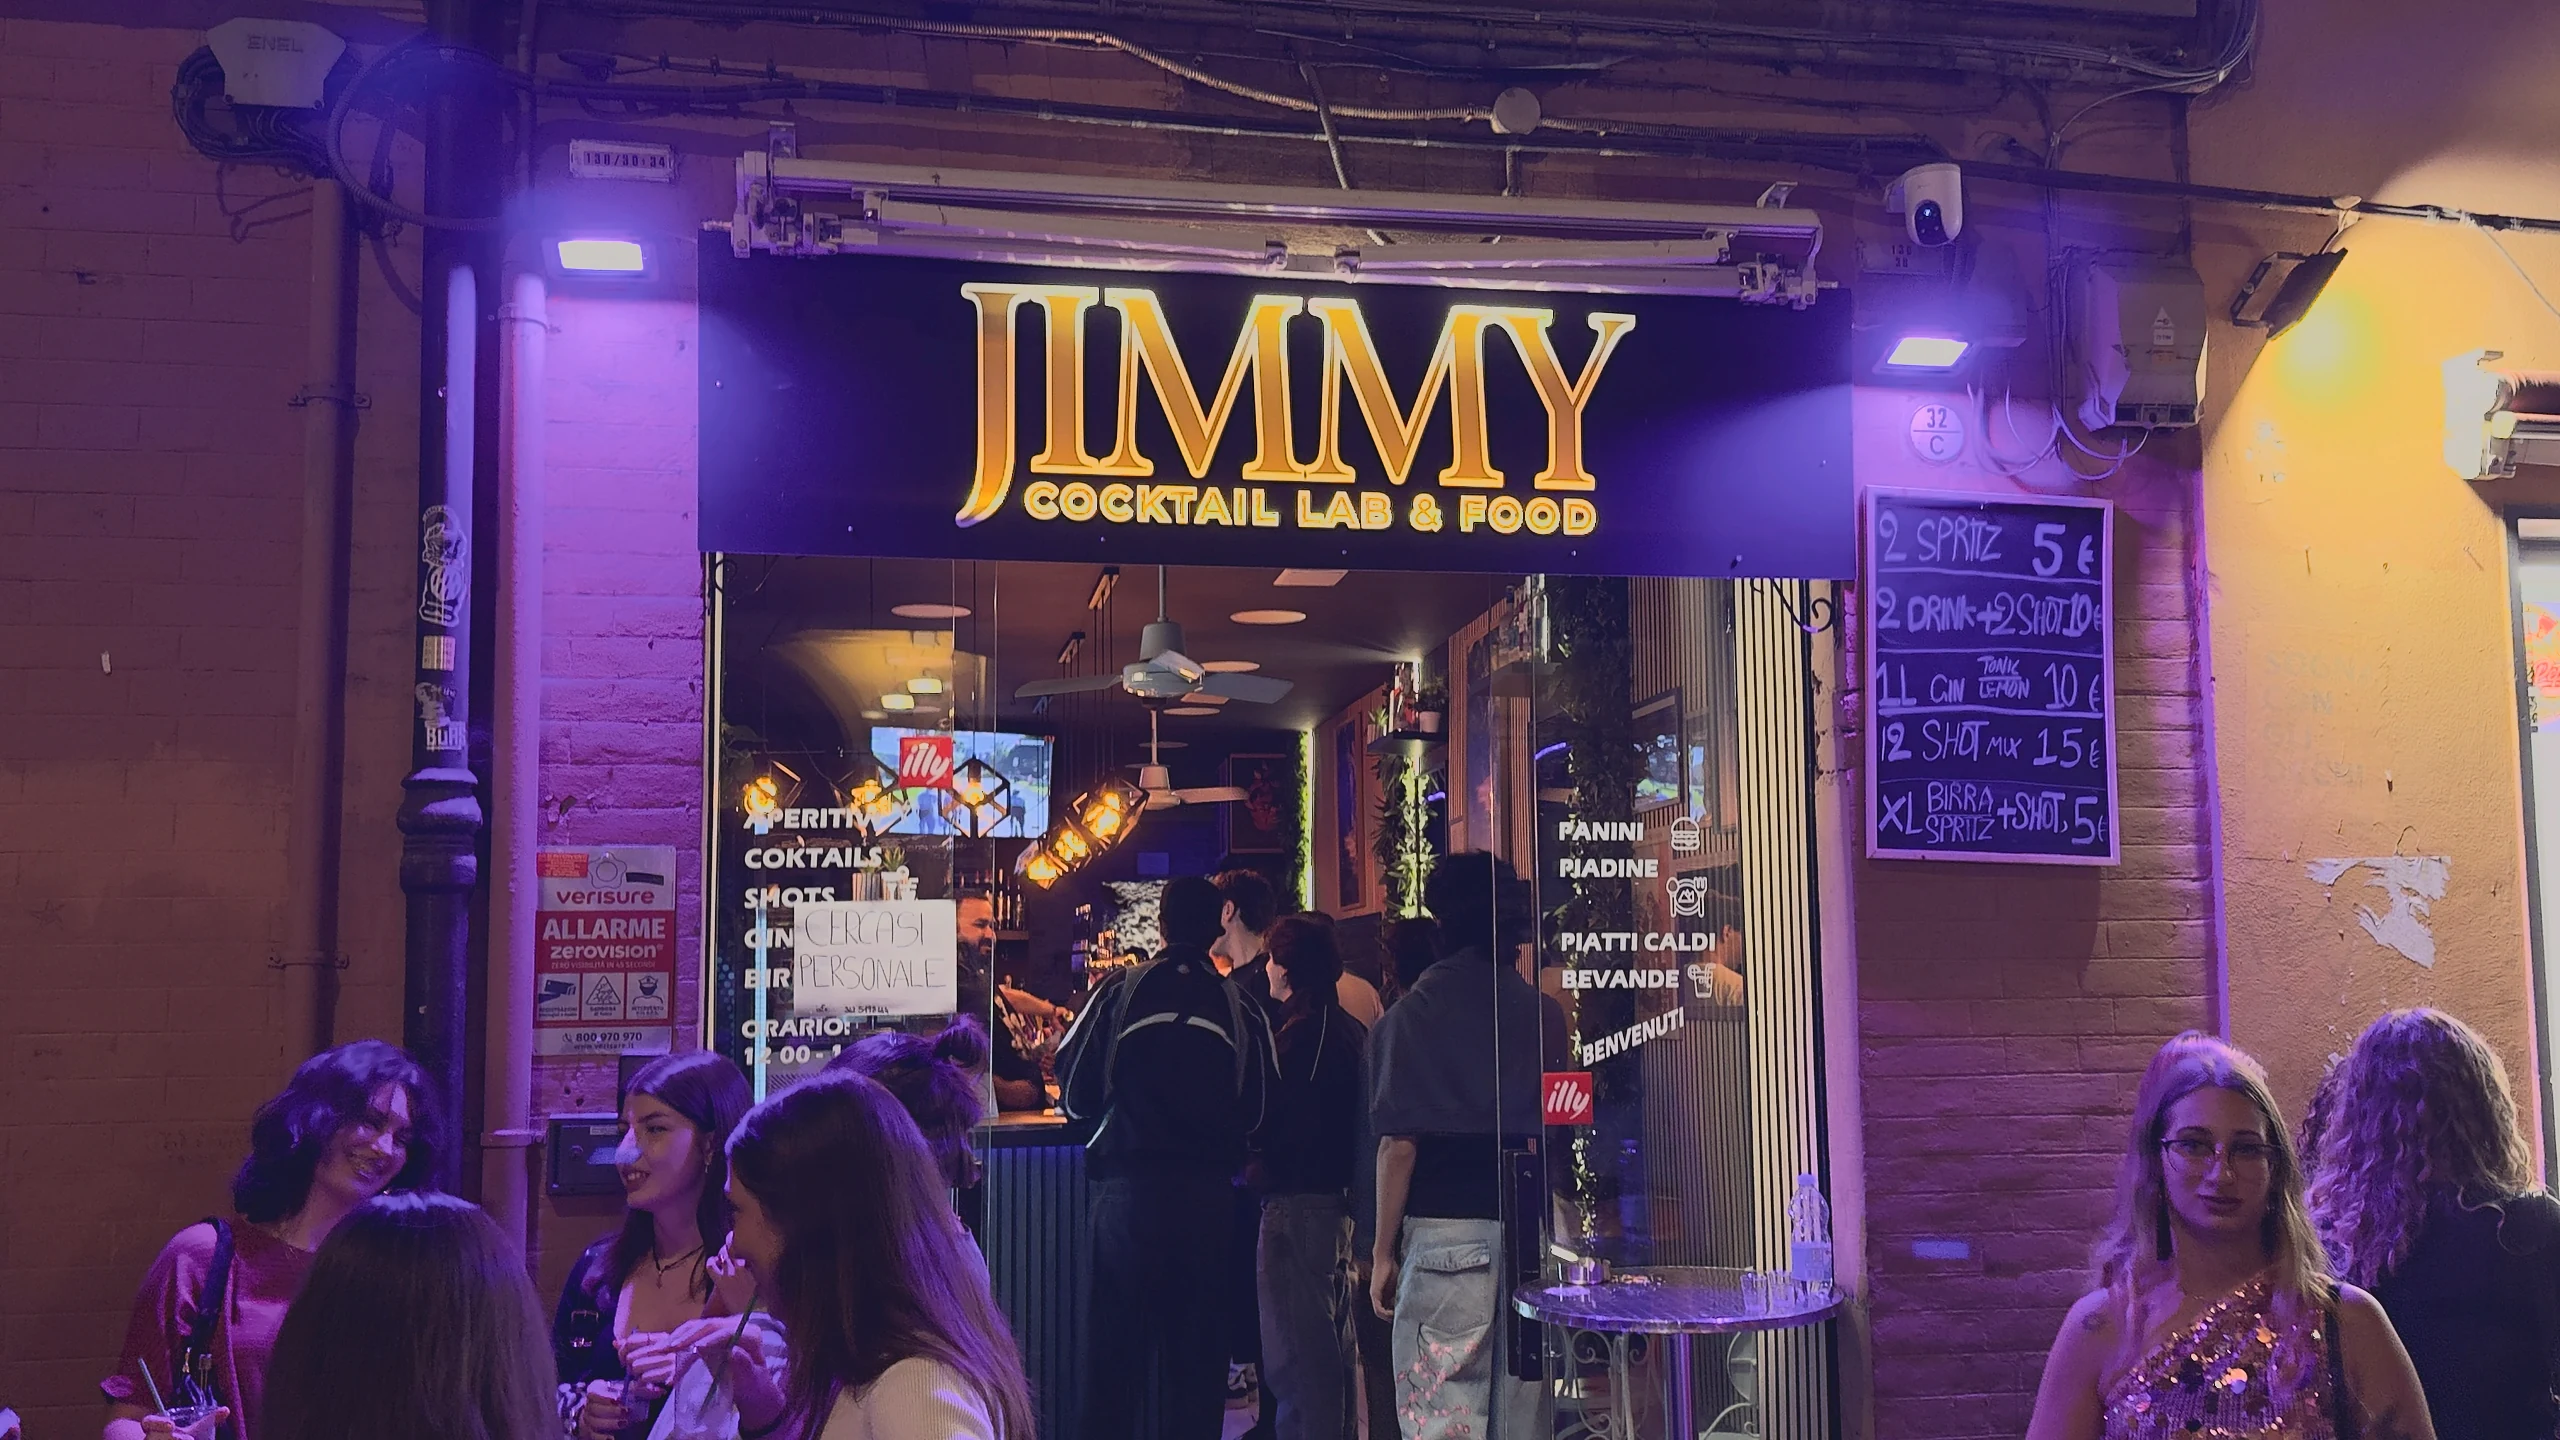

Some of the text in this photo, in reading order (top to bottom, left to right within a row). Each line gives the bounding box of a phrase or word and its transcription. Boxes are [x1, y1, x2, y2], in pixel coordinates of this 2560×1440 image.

[247, 35, 304, 53] ENEL
[955, 282, 1637, 528] JIMMY
[1926, 407, 1947, 428] 32
[1929, 435, 1945, 455] C
[1023, 480, 1598, 537] COCKTAIL LAB & FOOD
[1878, 509, 1907, 562] 2
[1917, 515, 2003, 562] SPRITZ
[2032, 523, 2066, 576] 5
[1876, 586, 1901, 629] 2
[1876, 661, 1917, 707] 1L
[1930, 673, 1966, 703] GIN
[1977, 655, 2020, 676] TONIC
[2043, 661, 2078, 710] 10
[1978, 678, 2031, 700] LEMON
[1881, 721, 1912, 762] 12
[1922, 718, 1990, 762] SHOT
[1986, 736, 2022, 760] MIX
[902, 742, 951, 786] illy
[743, 808, 881, 829] APERITIV
[1878, 791, 1923, 835] XL
[1927, 781, 1994, 814] BIRRA
[1558, 821, 1644, 841] PANINI
[1925, 815, 1996, 844] SPRITZ
[744, 847, 883, 869] COKTAILS
[1559, 858, 1659, 878] PIADINE
[556, 890, 655, 904] verisure
[744, 886, 835, 909] SHOTS
[542, 918, 666, 940] ALLARME
[805, 909, 924, 948] CERCASI
[1561, 931, 1716, 952] PIATTI CALDI
[744, 968, 790, 989] BIR
[799, 953, 946, 990] PERSONALE
[1562, 969, 1680, 989] BEVANDE
[576, 1032, 642, 1041] 800 970 970
[1582, 1006, 1685, 1067] BENVENUTI
[1547, 1080, 1590, 1120] illy
